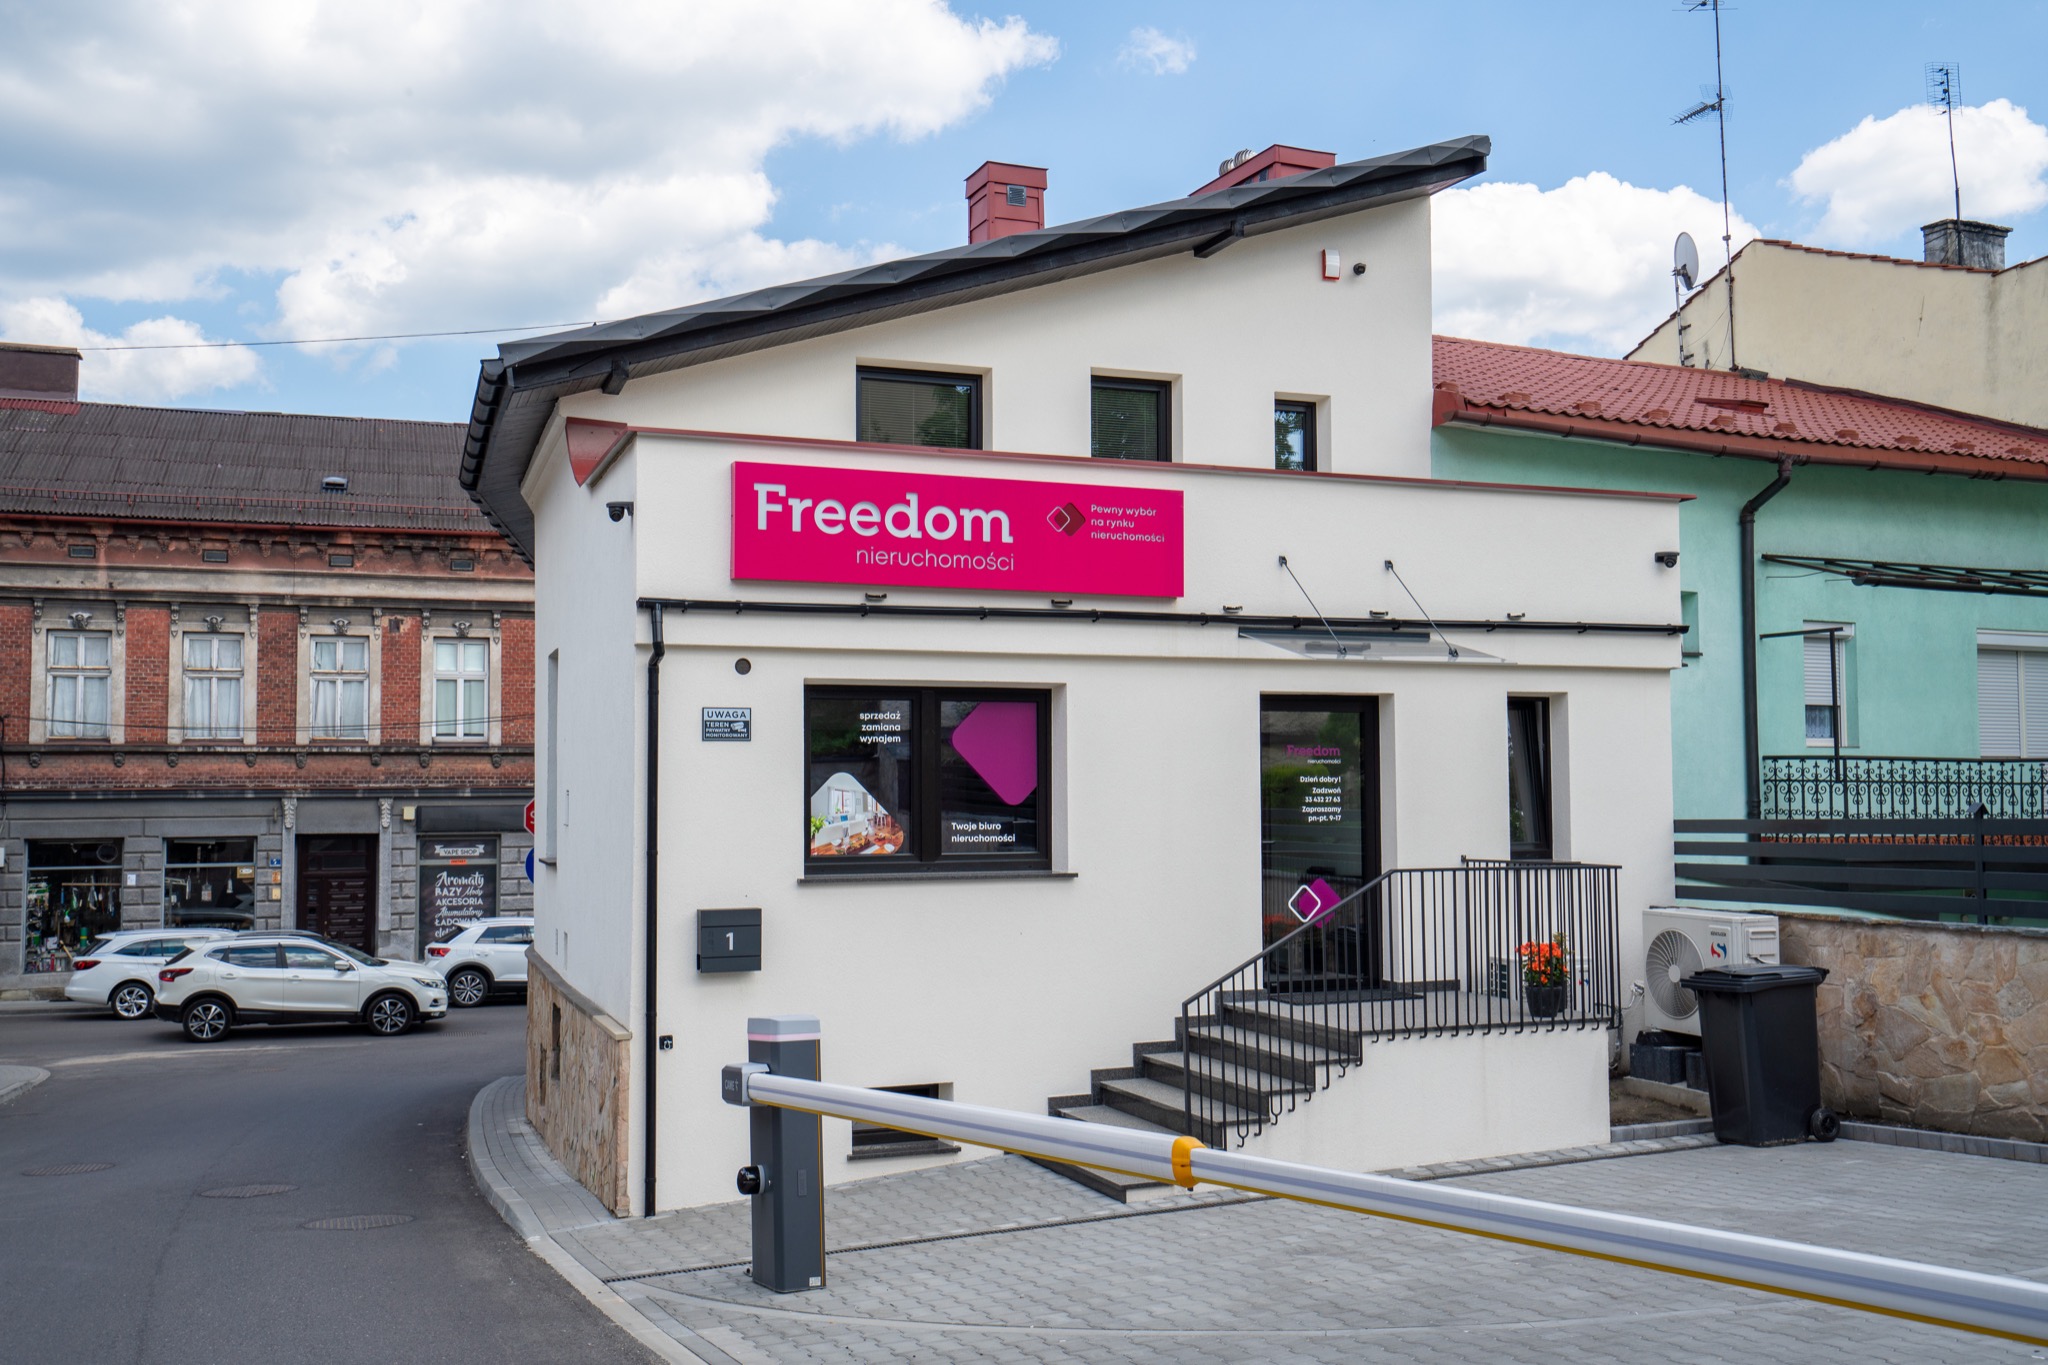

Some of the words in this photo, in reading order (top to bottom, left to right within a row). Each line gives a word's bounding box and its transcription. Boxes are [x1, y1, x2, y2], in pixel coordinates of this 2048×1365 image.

[754, 483, 1013, 543] Freedom
[1091, 504, 1123, 516] Pewny
[1126, 507, 1156, 517] wybór
[1091, 518, 1104, 526] na
[1106, 519, 1134, 529] rynku
[1091, 530, 1165, 542] nieruchomości
[856, 546, 1014, 571] nieruchomości
[707, 711, 747, 719] UWAGA
[860, 711, 901, 721] sprzedaż
[861, 723, 901, 731] zamiana
[860, 734, 901, 744] wynajem
[1286, 745, 1341, 757] Freedom
[1302, 806, 1341, 814] Zapraszamy
[1308, 815, 1328, 823] pn-pt.
[951, 822, 977, 832] Twoje
[979, 822, 1002, 830] biuro
[951, 834, 1016, 843] nieruchomości
[435, 871, 484, 888] Aromaty
[435, 887, 462, 896] BAZY
[435, 897, 484, 906] AKCESORIA
[435, 906, 484, 918] Akumulatory
[726, 932, 734, 951] 1
